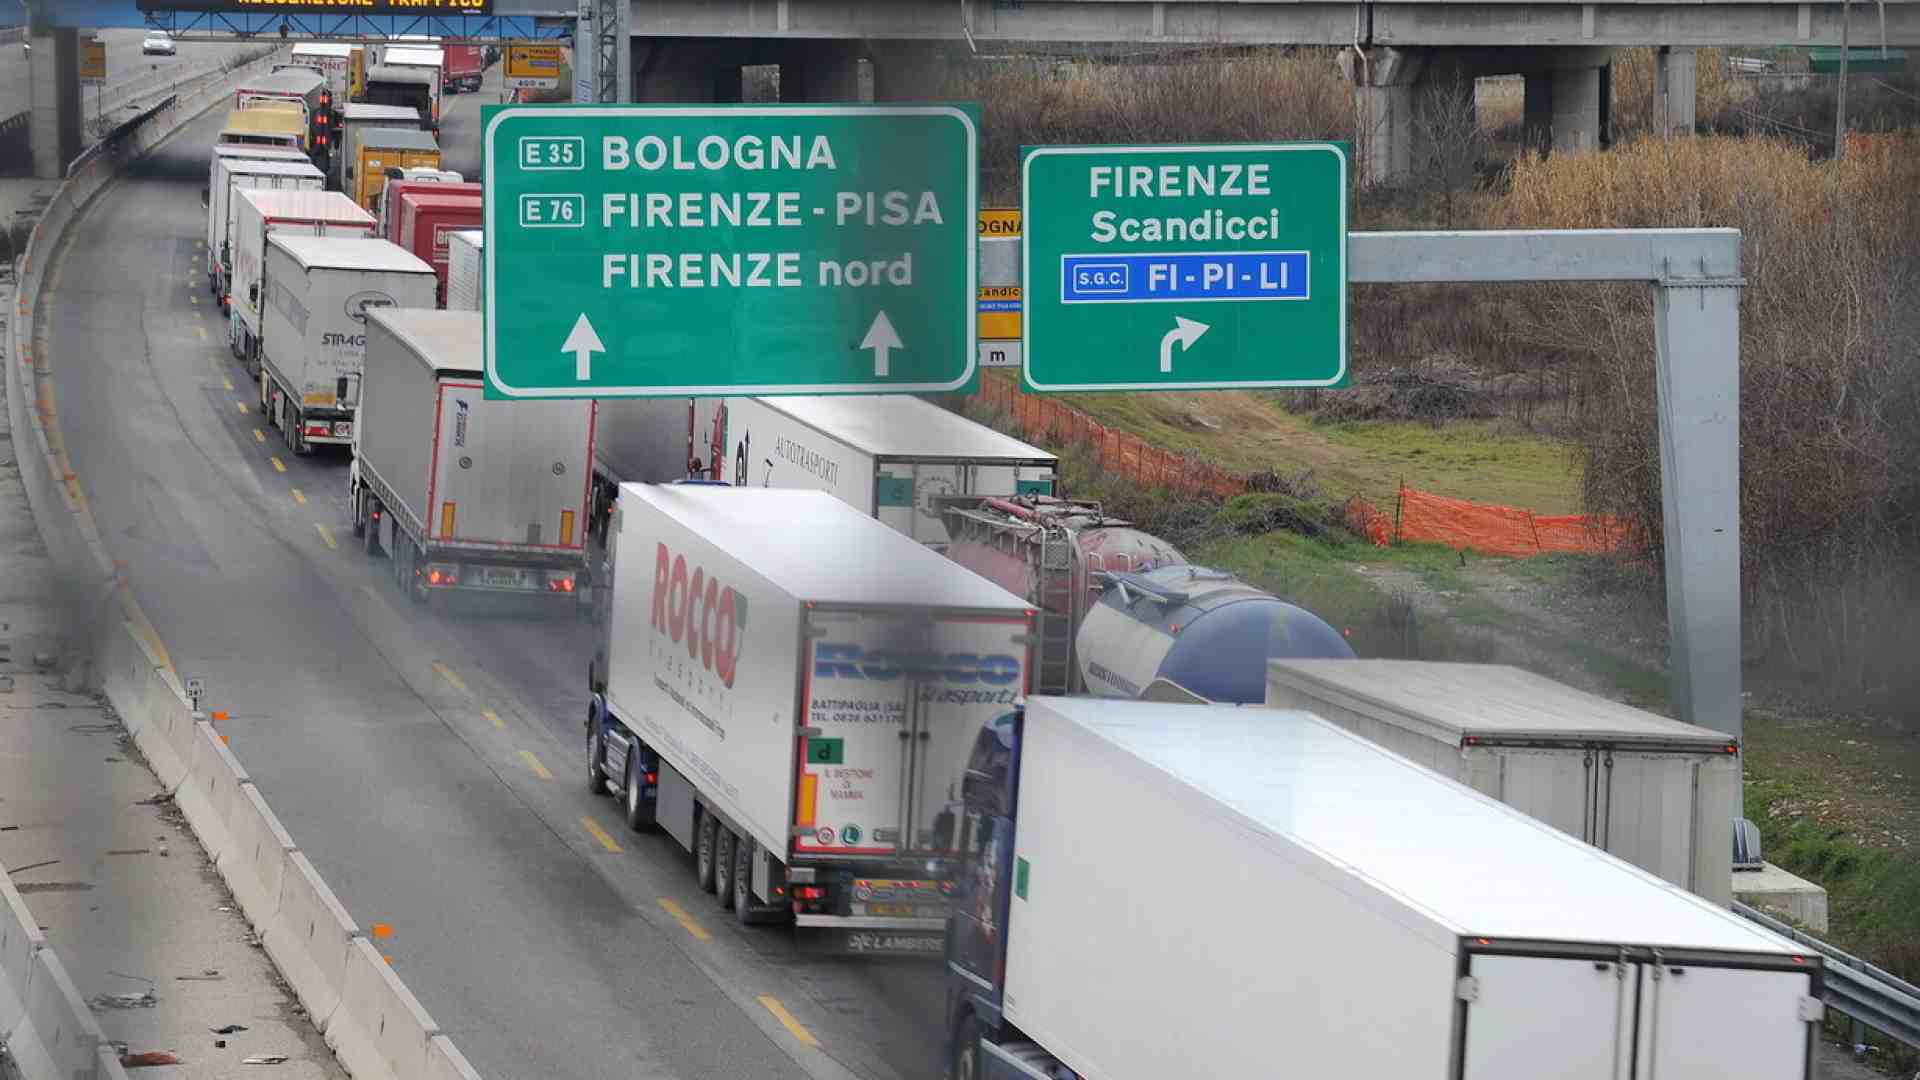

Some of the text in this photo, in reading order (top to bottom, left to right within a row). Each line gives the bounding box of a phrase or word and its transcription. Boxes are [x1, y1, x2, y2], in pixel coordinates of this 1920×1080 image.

[527, 143, 574, 164] E 35
[603, 135, 836, 170] BOLOGNA
[1090, 164, 1271, 198] FIRENZE
[527, 200, 573, 221] E 76
[603, 192, 802, 227] FIRENZE
[836, 191, 944, 225] PISA
[1091, 207, 1279, 243] Scandicci
[603, 252, 912, 288] FIRENZE nord
[1078, 272, 1124, 285] S.G.C.
[776, 433, 840, 488] AUTOTRASPORTI
[652, 541, 737, 690] ROCCO
